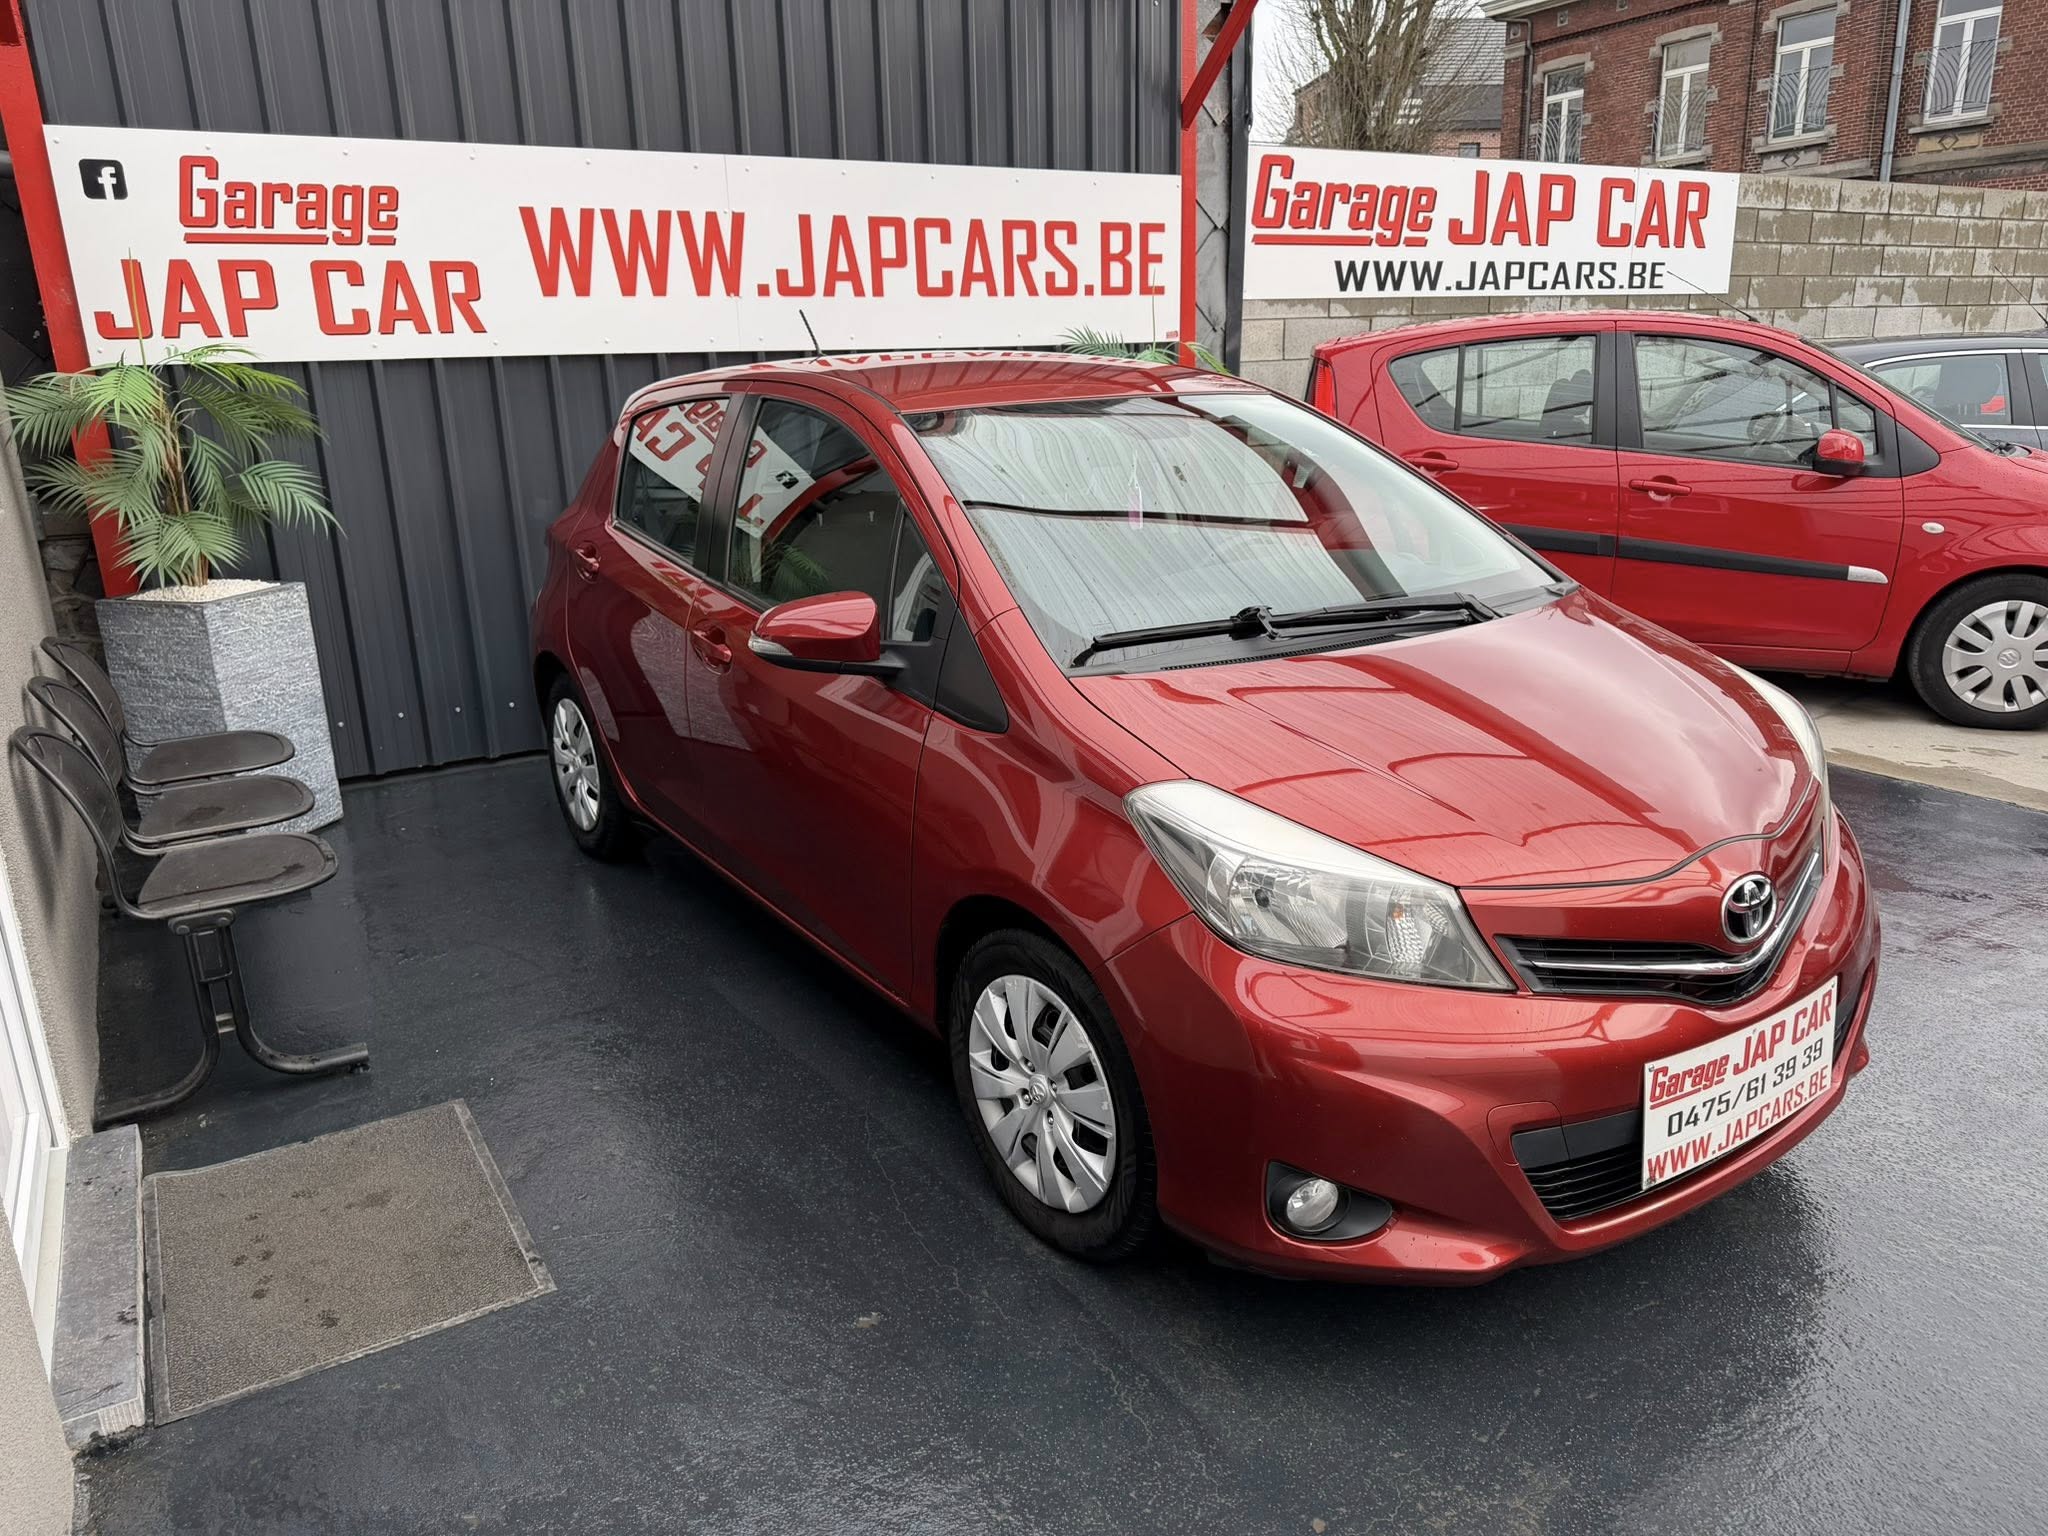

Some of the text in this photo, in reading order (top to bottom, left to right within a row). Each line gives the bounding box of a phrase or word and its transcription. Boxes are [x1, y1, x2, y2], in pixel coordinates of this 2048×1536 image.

[179, 155, 399, 245] Garage
[1252, 154, 1710, 249] Garage JAP CAR
[519, 206, 1167, 298] WWW.JAPCARS.BE
[1334, 260, 1666, 292] WWW.JAPCARS.BE
[94, 258, 488, 341] JAP CAR
[1649, 988, 1833, 1105] Garage JAP CAR
[1666, 1037, 1824, 1138] 0475/61 39 39
[1647, 1064, 1829, 1183] WWW.JAPCARS.BE
